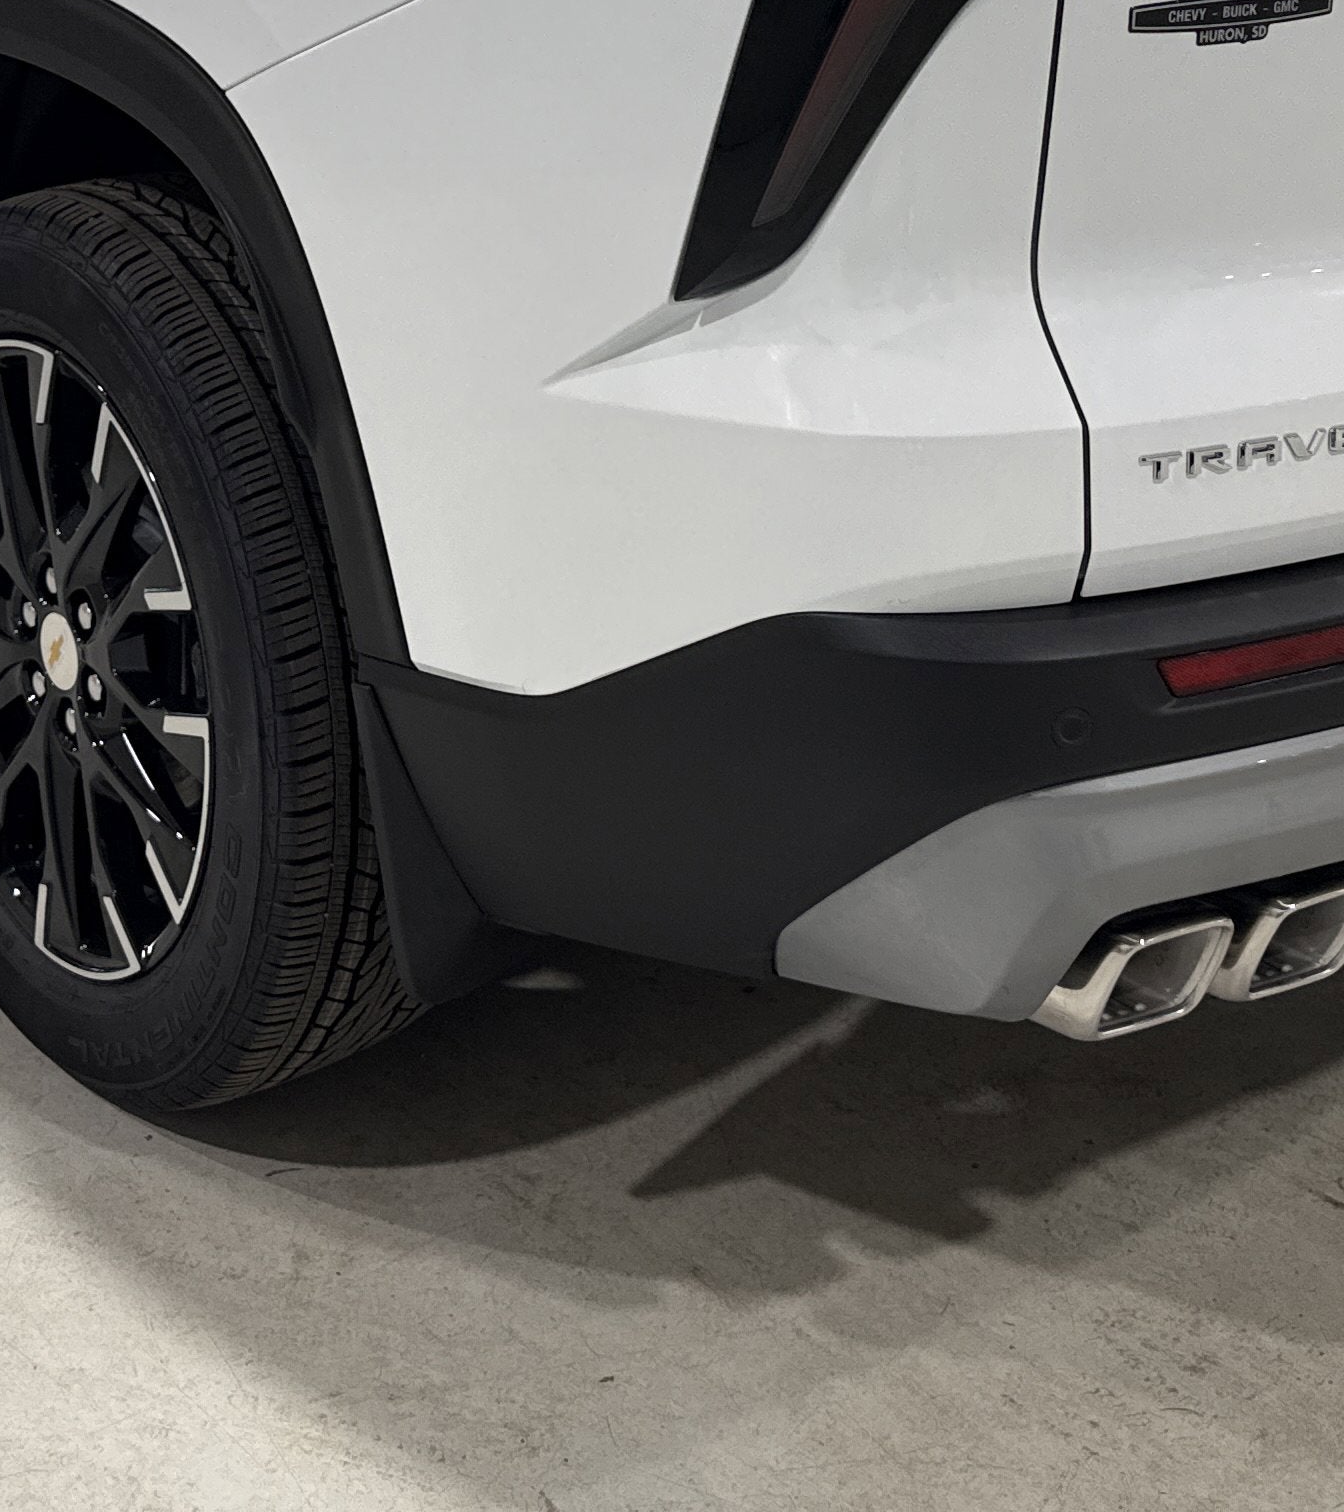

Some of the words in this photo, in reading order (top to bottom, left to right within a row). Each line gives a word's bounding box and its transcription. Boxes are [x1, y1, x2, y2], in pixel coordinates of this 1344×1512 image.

[1168, 7, 1206, 23] CHEVY
[1223, 3, 1257, 19] BUICK
[1273, 0, 1300, 14] GMC
[1199, 27, 1247, 43] HURON,
[1252, 25, 1267, 39] SD
